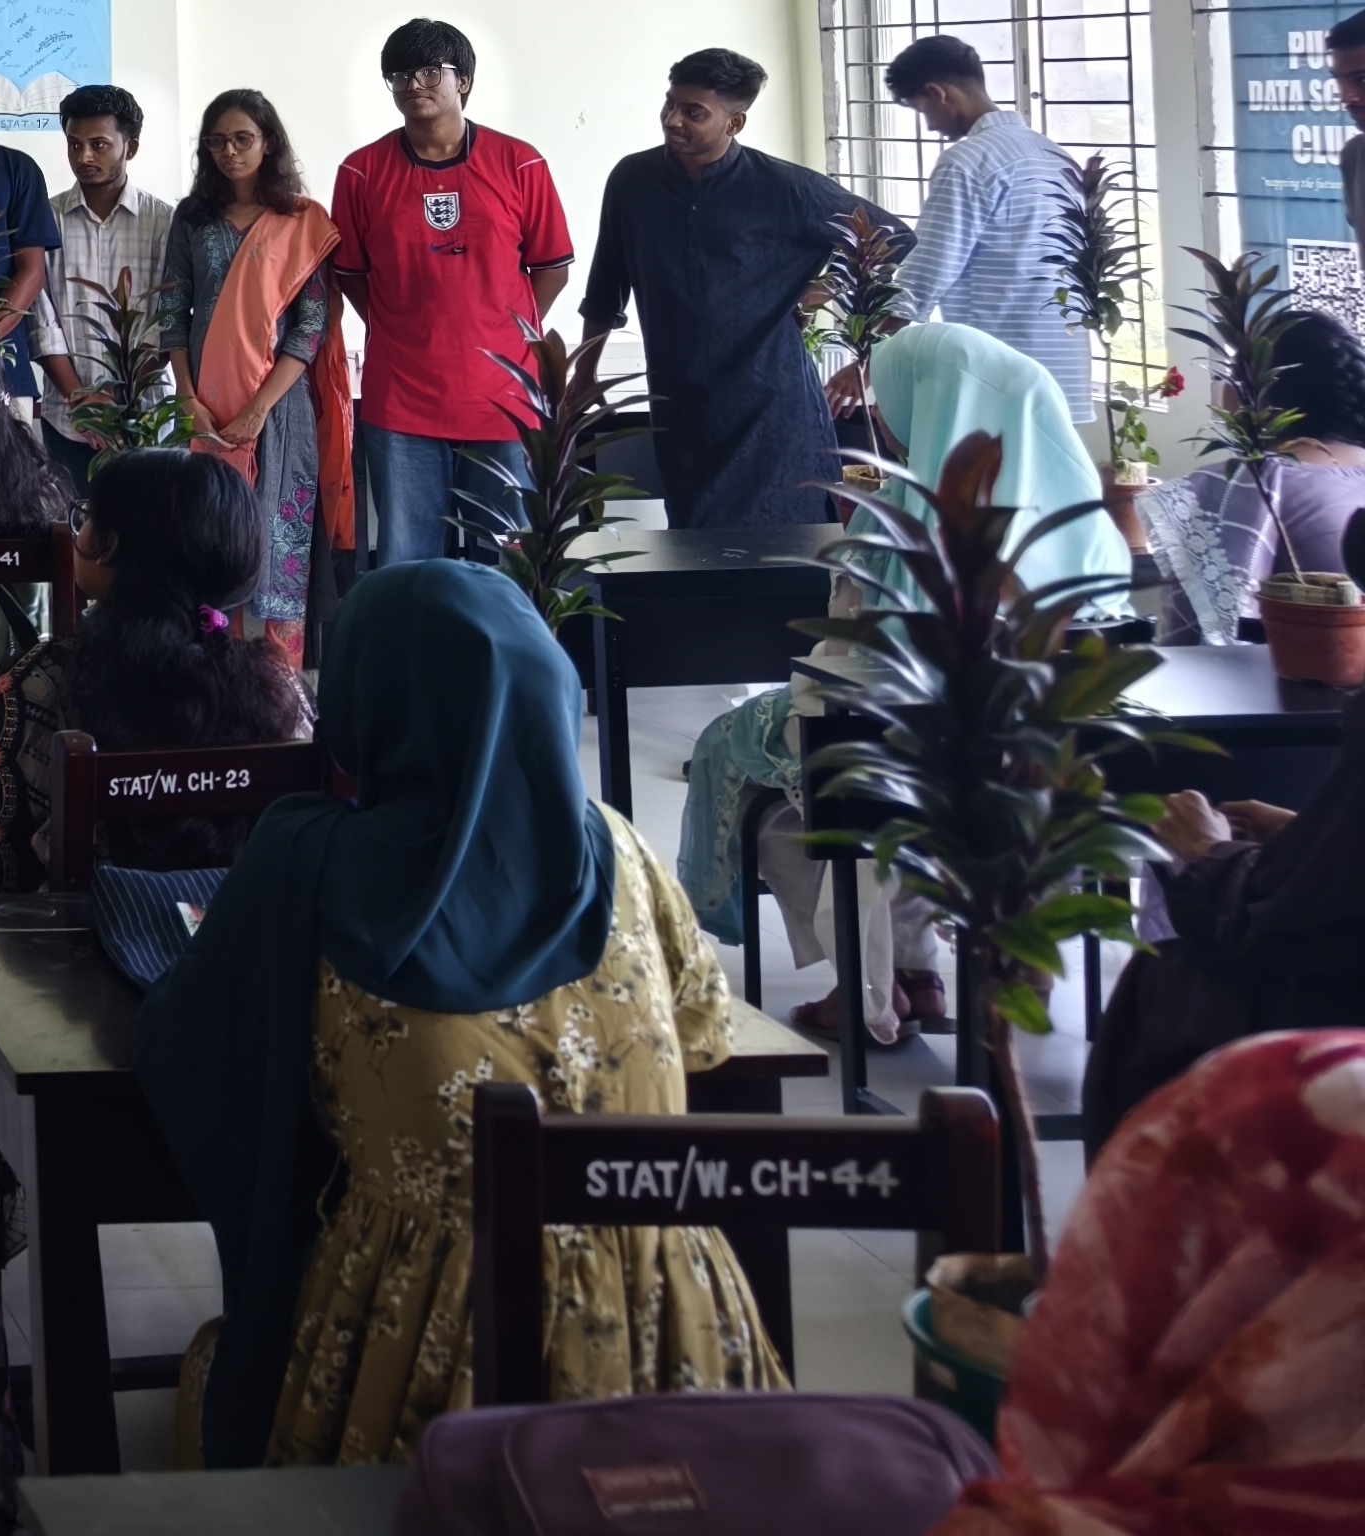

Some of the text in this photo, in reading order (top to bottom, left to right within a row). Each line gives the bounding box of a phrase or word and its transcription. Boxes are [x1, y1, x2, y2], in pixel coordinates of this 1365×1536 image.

[1248, 78, 1349, 112] DATA SC
[108, 768, 251, 801] STAT/W. CH-23
[585, 1144, 901, 1212] STAT/W. CH-44
